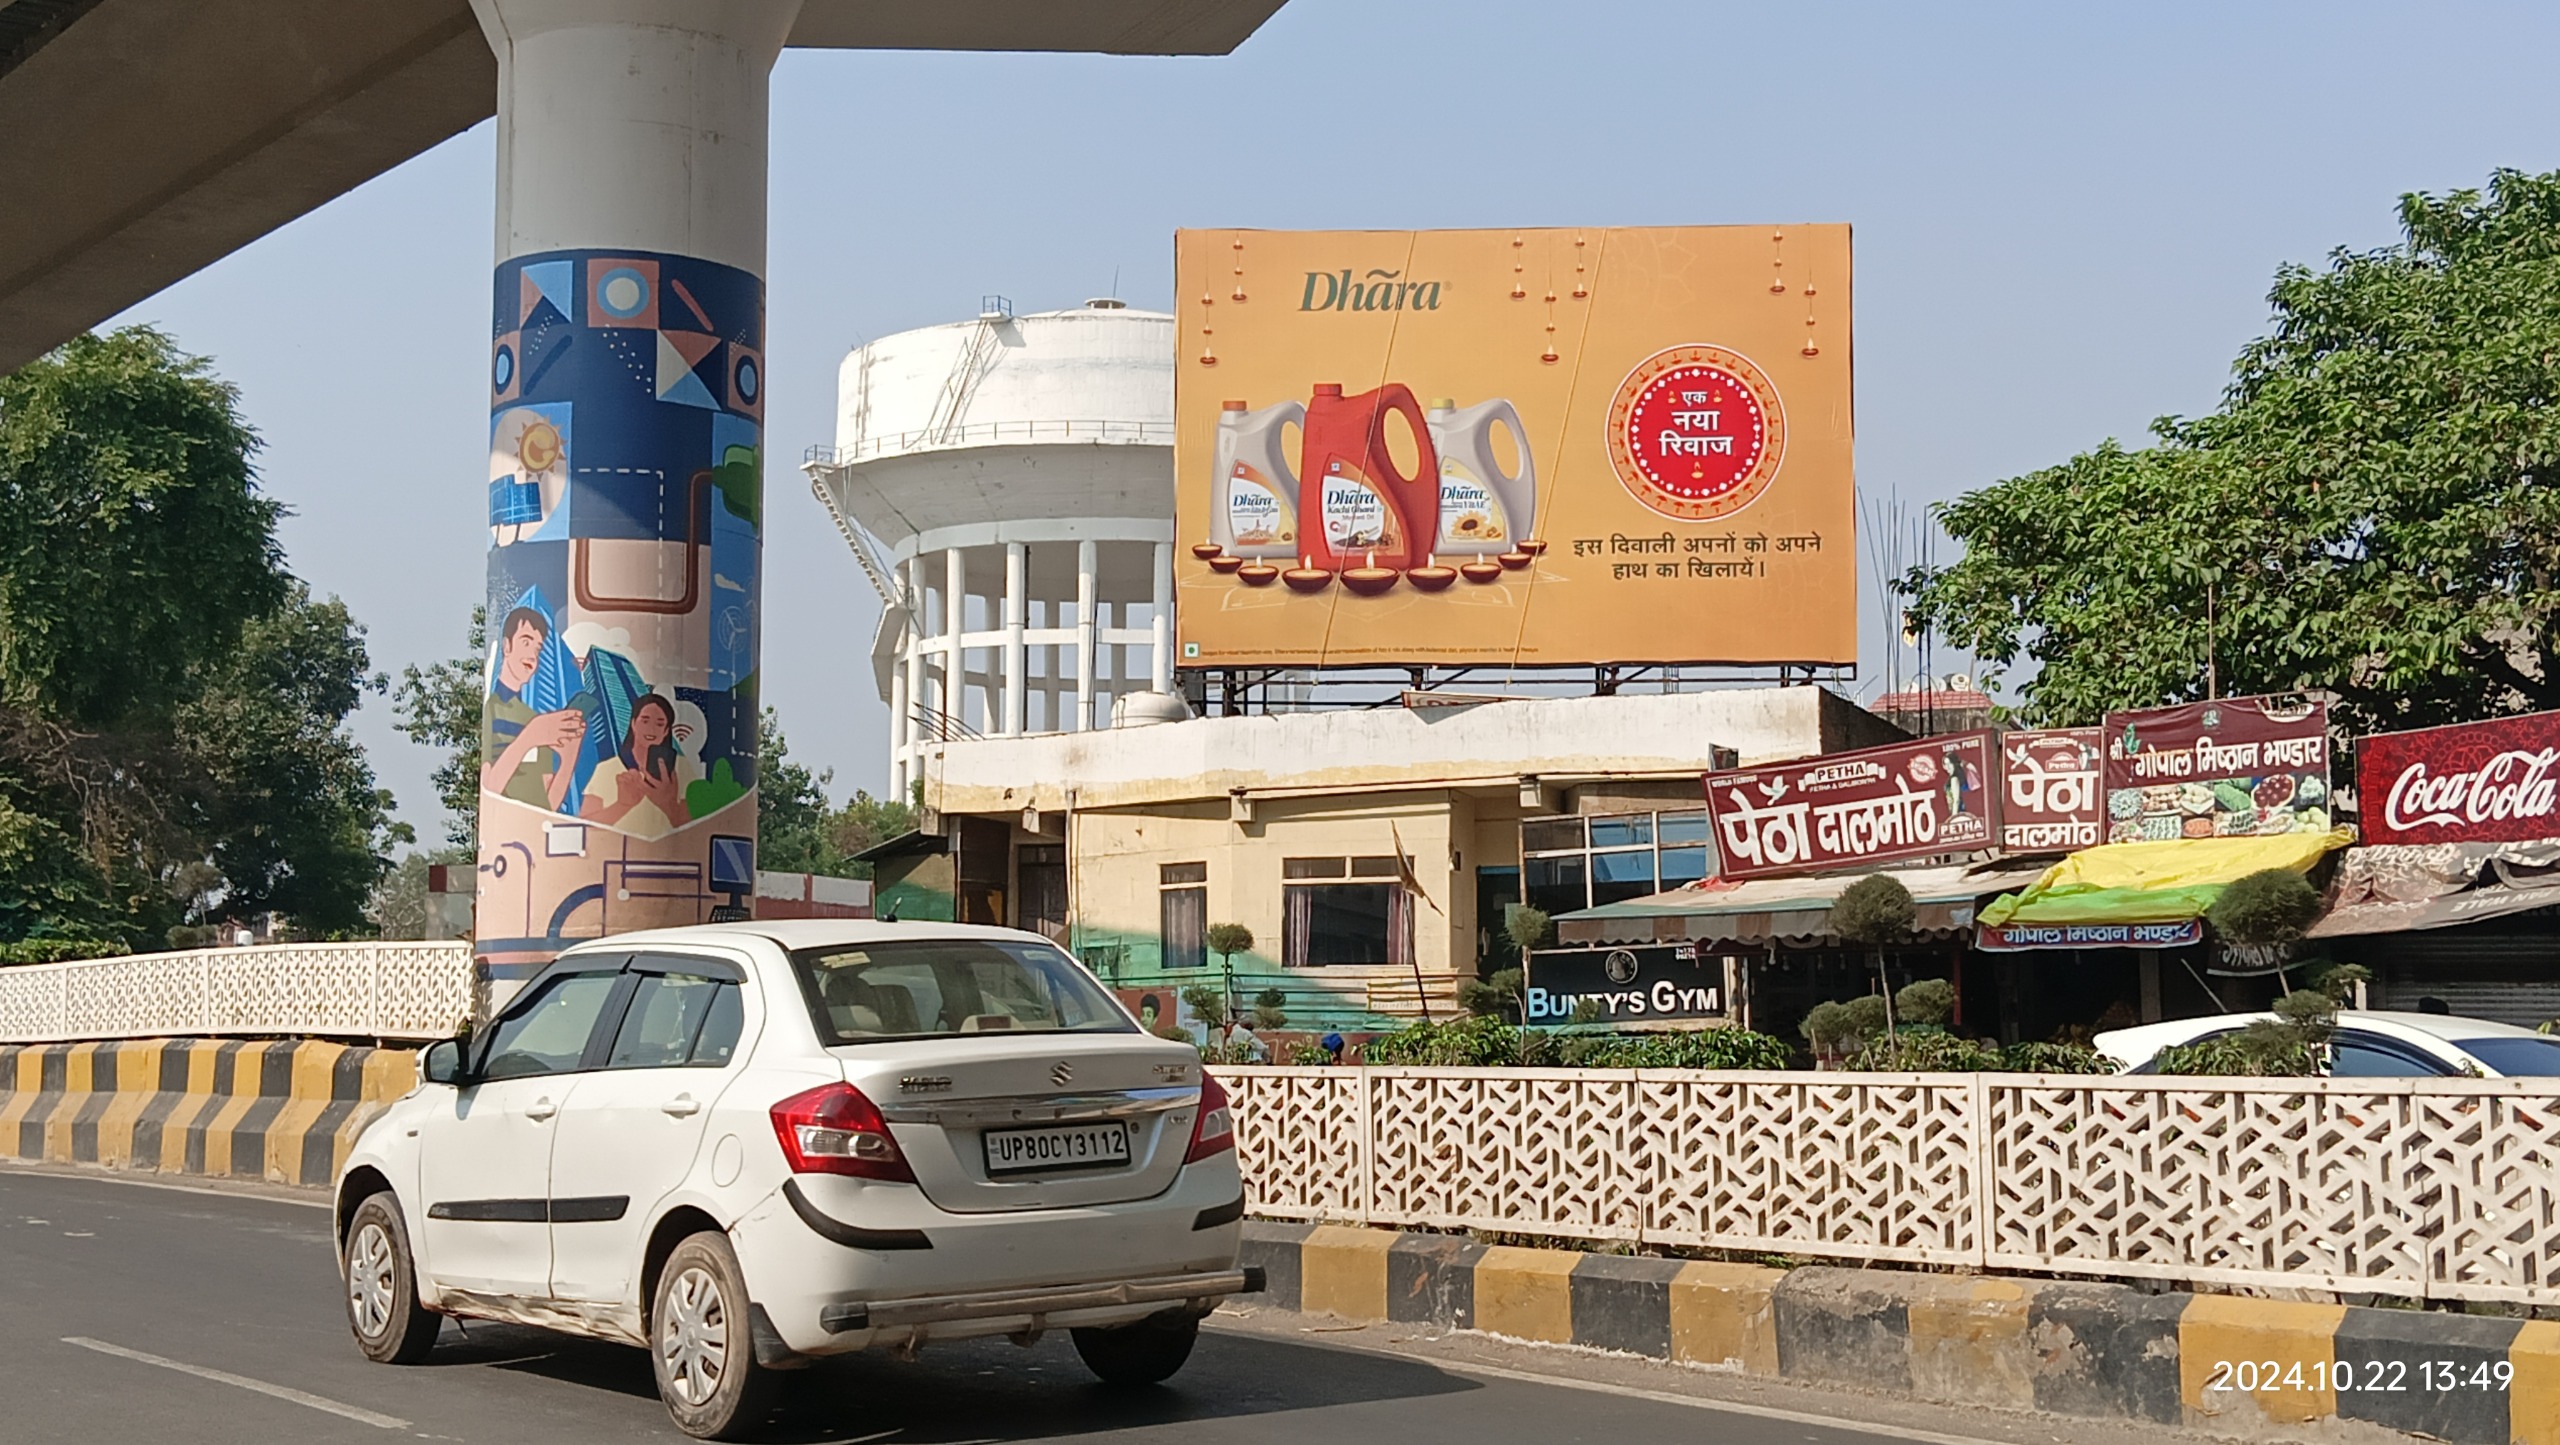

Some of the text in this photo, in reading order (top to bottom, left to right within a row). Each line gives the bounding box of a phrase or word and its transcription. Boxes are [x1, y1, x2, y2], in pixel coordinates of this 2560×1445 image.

[1681, 391, 1708, 407] एक
[1671, 409, 1720, 431] नया
[1658, 430, 1734, 457] रिवाज
[1573, 531, 1822, 557] इस दिवाली अपनों को अपने
[1612, 562, 1648, 580] हाथ
[1655, 562, 1680, 579] का
[2109, 736, 2123, 761] श्री
[2129, 743, 2194, 778] गोपाल
[2263, 735, 2324, 767] भण्डार
[1817, 763, 1865, 781] PETHA
[2008, 756, 2100, 813] पेठा
[2385, 747, 2560, 831] Coca-Cola
[1719, 772, 1937, 866] पेठा दालमोठ
[1940, 819, 1983, 836] PETHA
[2004, 812, 2098, 848] दालमोठ
[2003, 925, 2062, 943] गोपाल
[1651, 981, 1718, 1013] GYM
[1000, 1130, 1125, 1161] UP80CY3112
